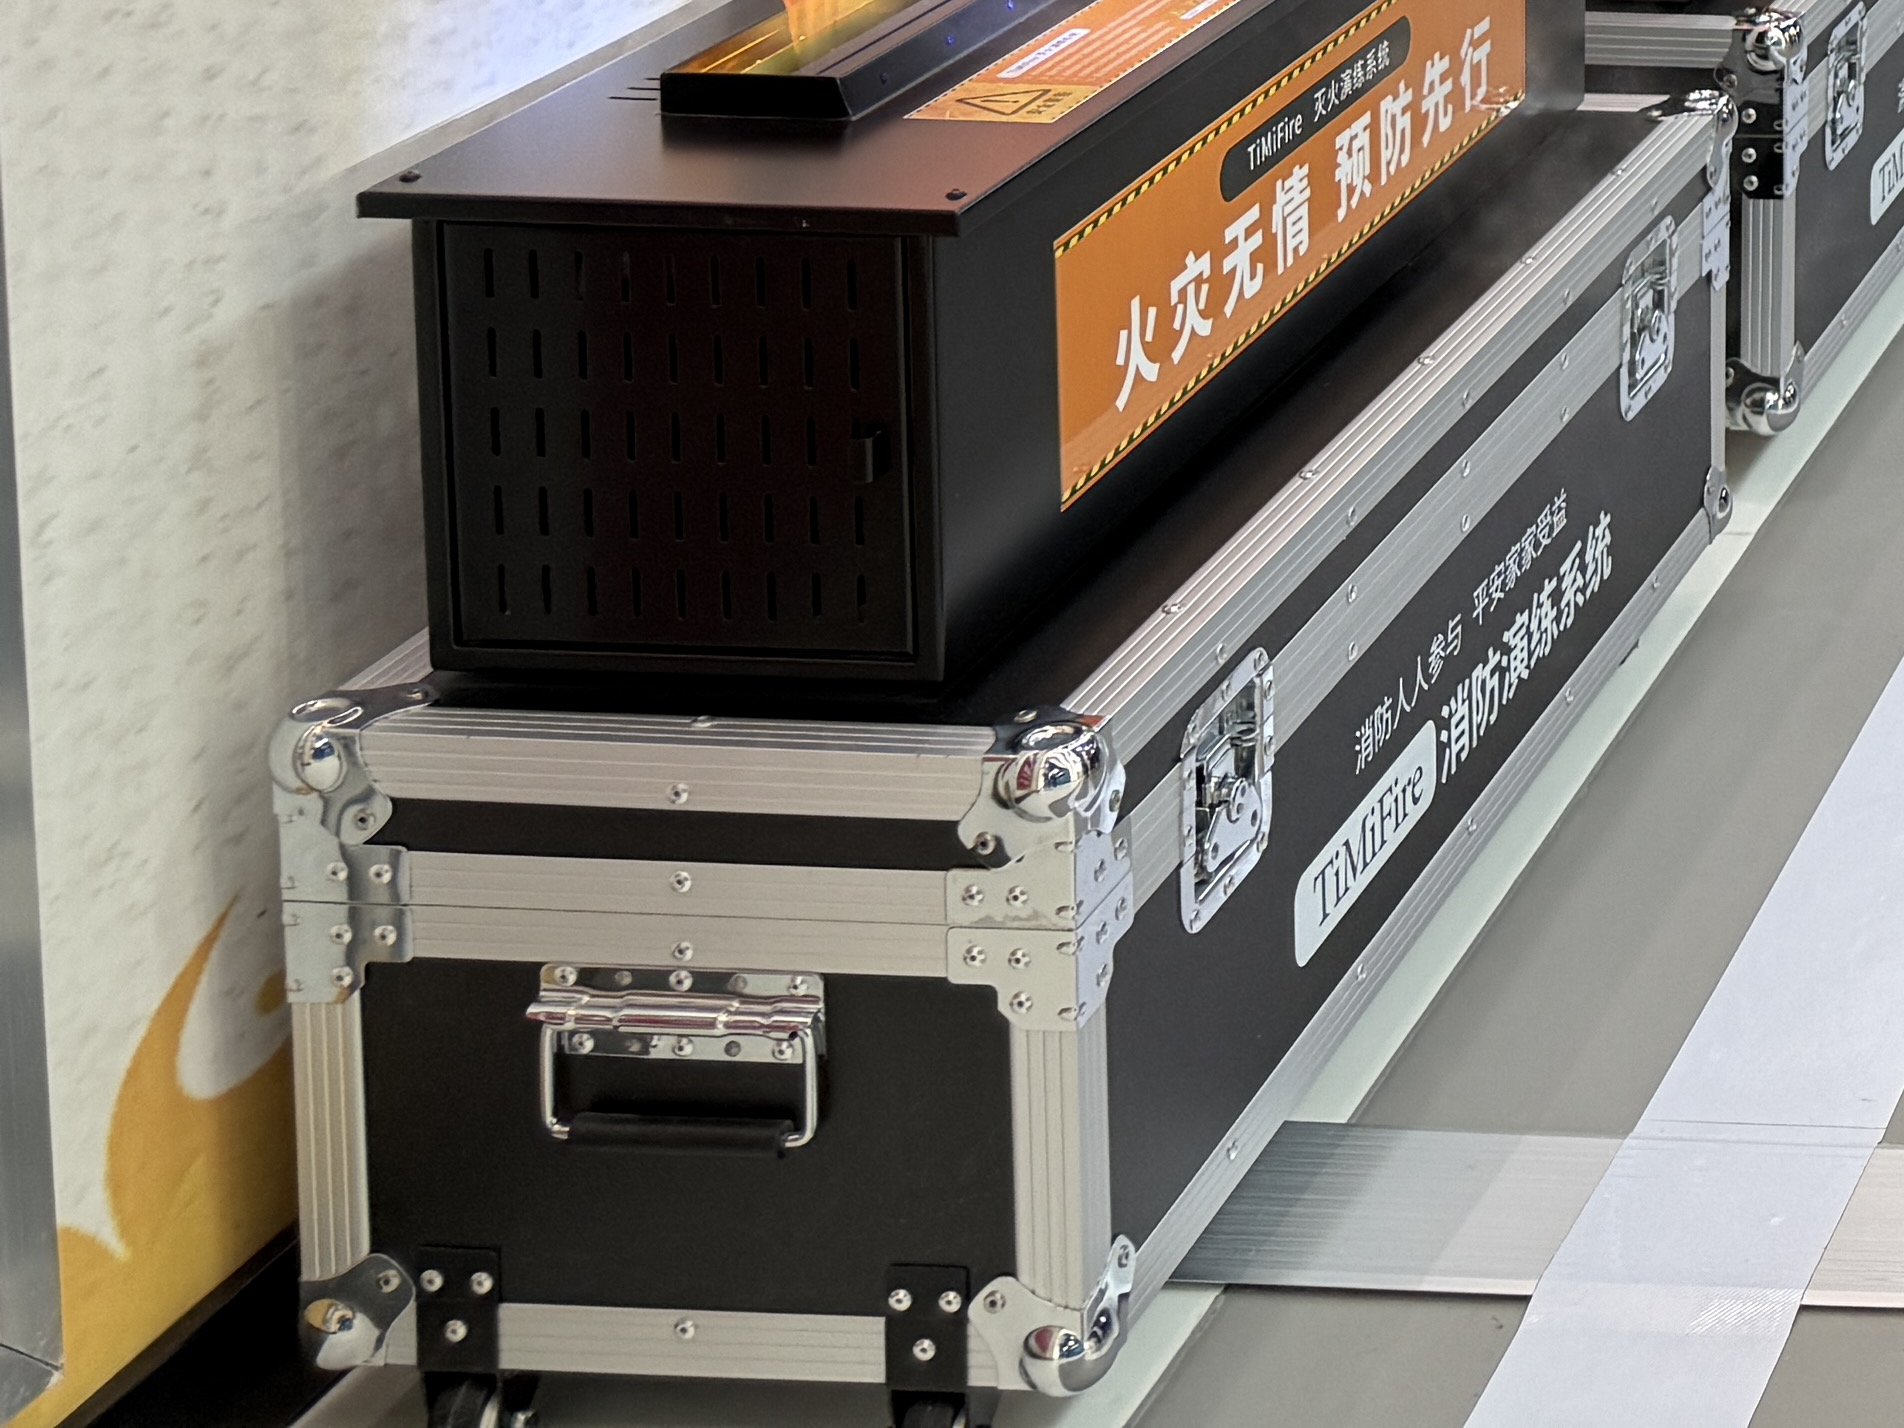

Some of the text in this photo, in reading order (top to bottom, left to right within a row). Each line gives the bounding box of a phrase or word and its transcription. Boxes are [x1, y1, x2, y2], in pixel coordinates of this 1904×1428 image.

[1114, 15, 1492, 412] 火灾无情 预防先行
[1246, 39, 1391, 172] TiMiFire 灭火演练系统
[1311, 510, 1613, 928] TiMiFire 消防演练系统
[1353, 487, 1569, 775] 消防人人参与 平安家家受益
